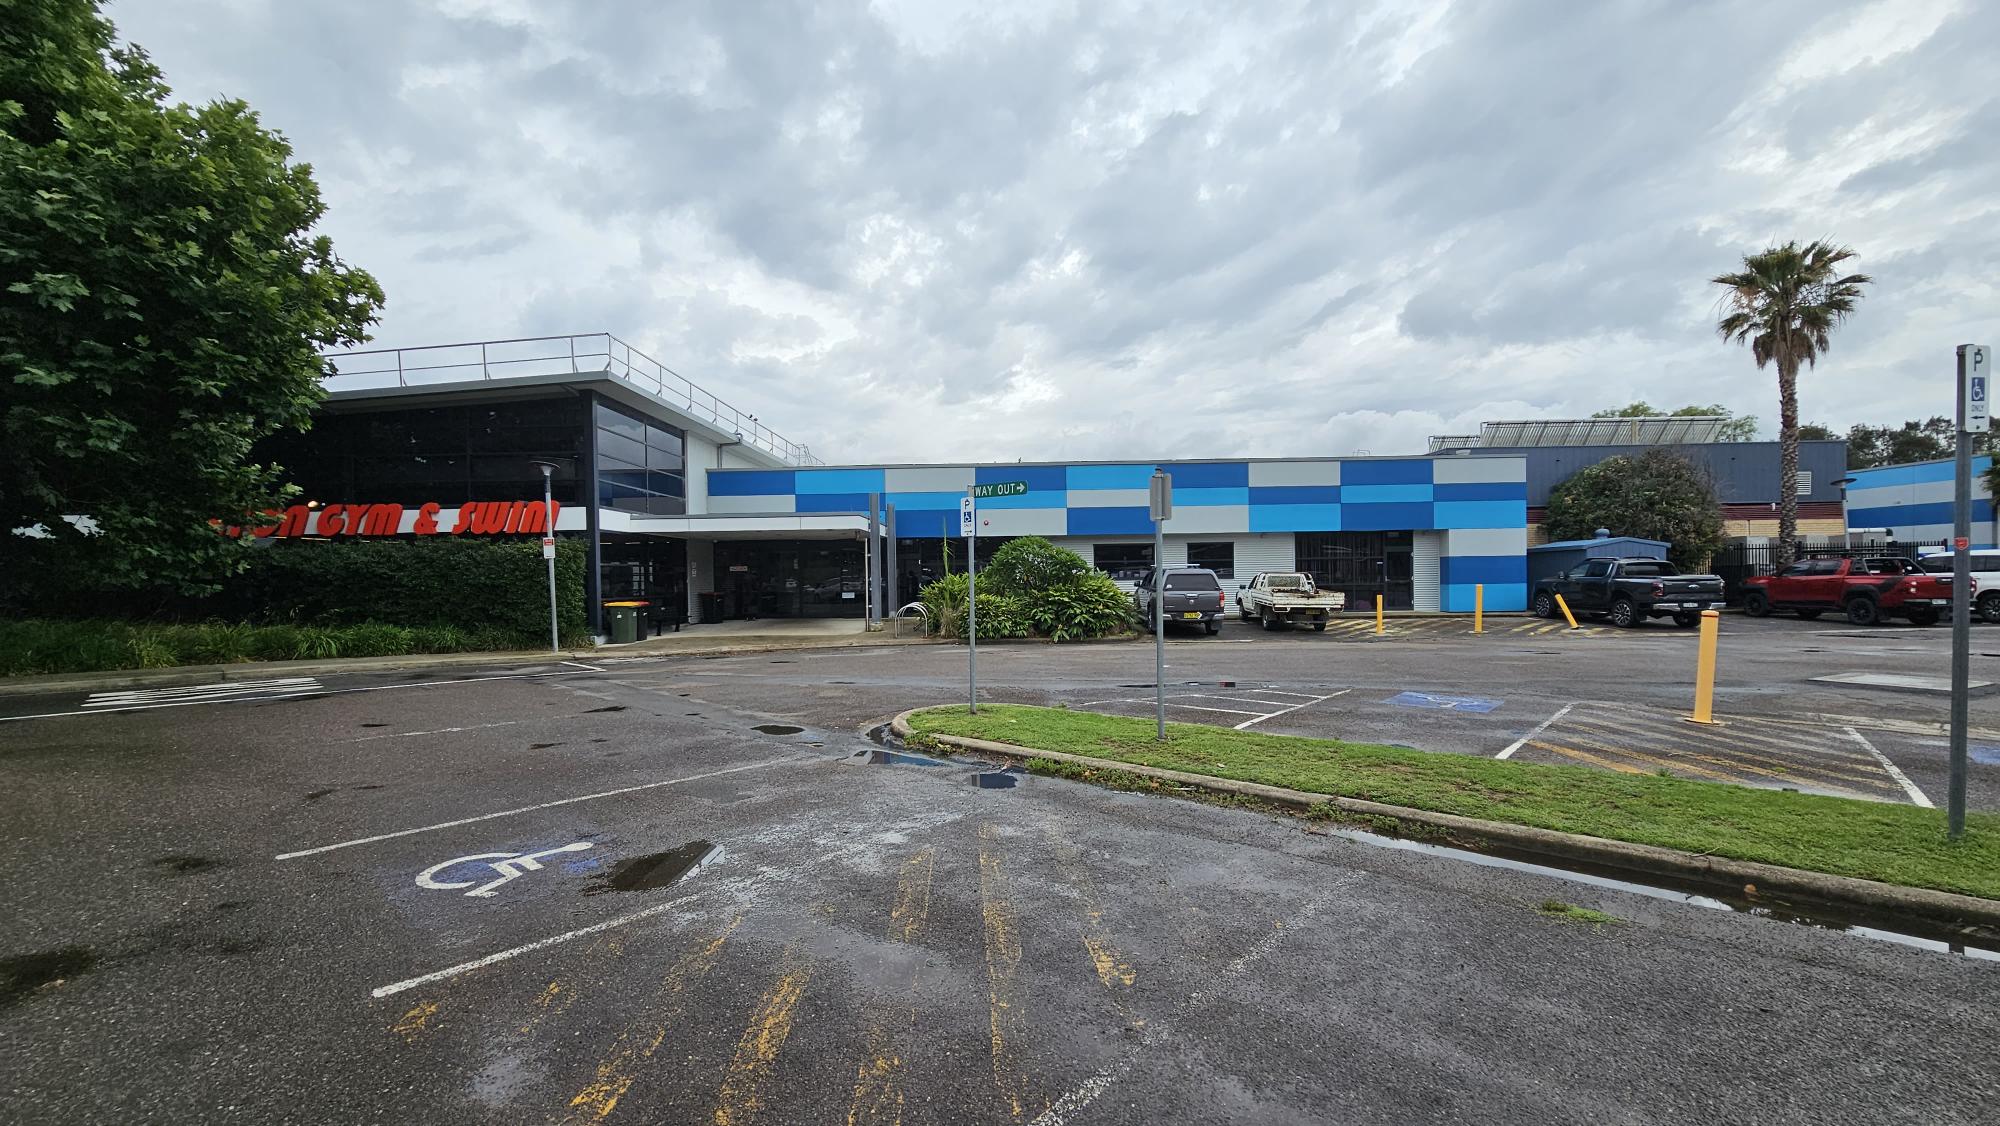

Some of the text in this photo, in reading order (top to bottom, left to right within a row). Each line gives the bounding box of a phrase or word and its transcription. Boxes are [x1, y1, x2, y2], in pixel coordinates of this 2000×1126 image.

[1974, 351, 1984, 372] P
[975, 483, 1016, 497] WAY OUT
[964, 499, 971, 510] P
[316, 502, 404, 536] GYM
[413, 502, 440, 535] &
[452, 500, 560, 535] SWIM
